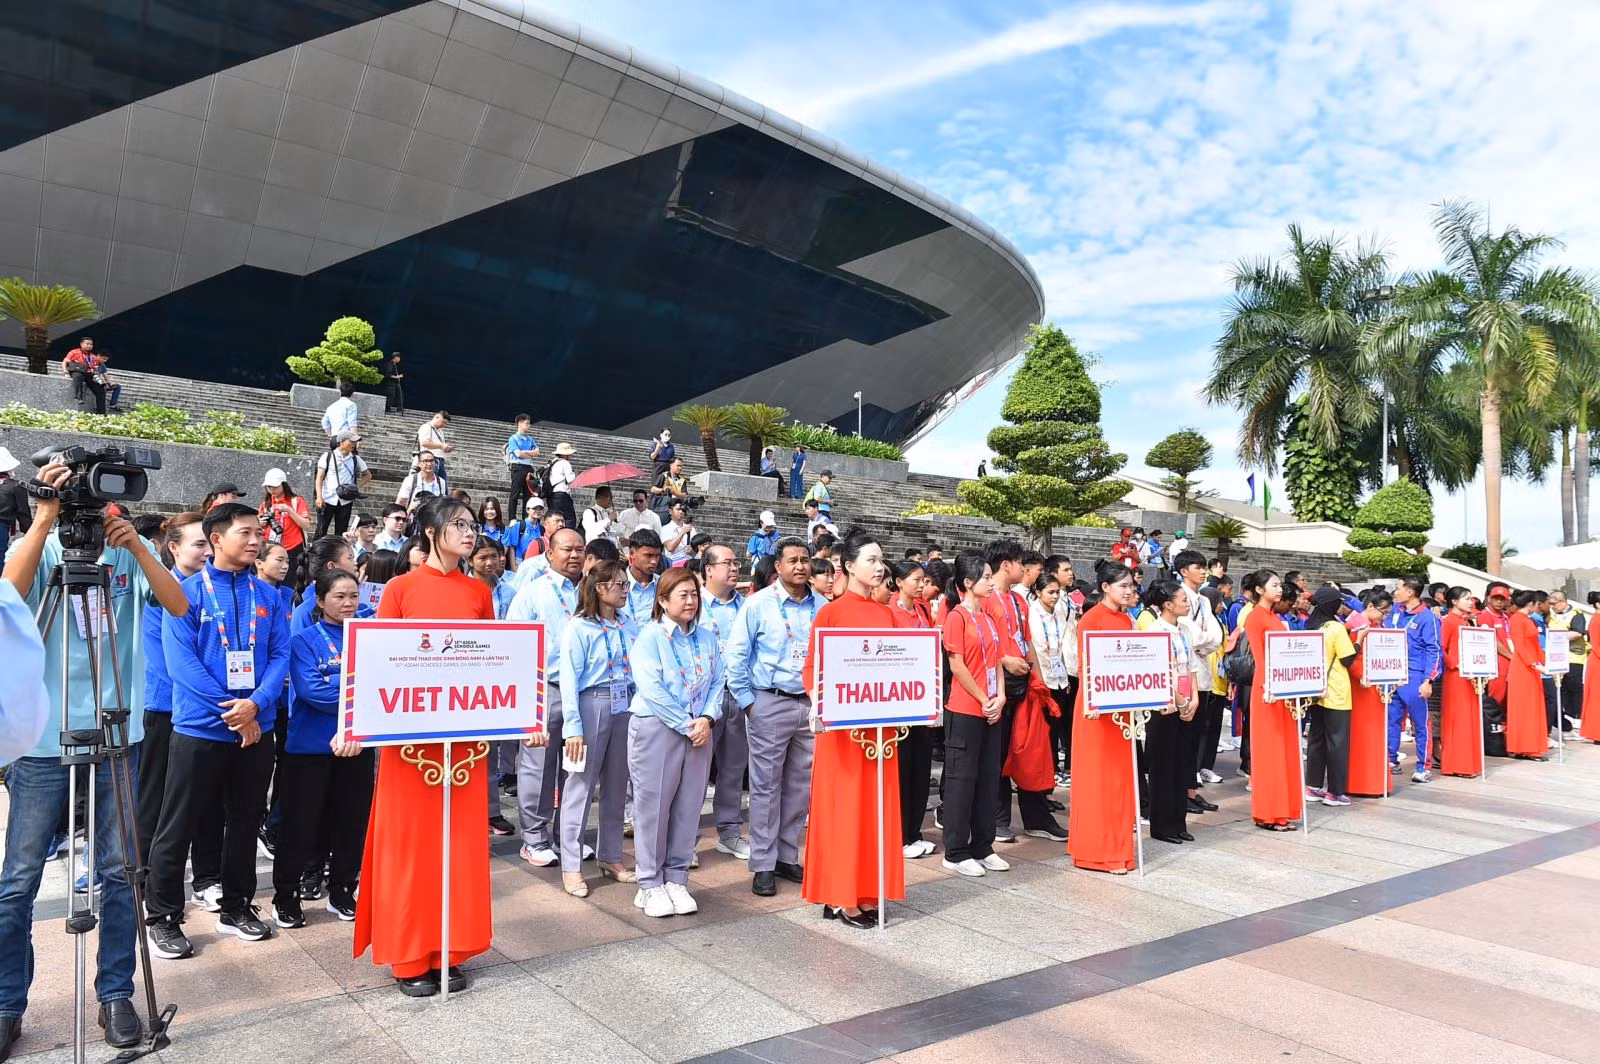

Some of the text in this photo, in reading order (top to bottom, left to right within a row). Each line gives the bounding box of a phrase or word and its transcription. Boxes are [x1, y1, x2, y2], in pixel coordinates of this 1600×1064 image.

[1371, 658, 1402, 670] MALAYSIA
[1472, 654, 1487, 664] LAOS
[1094, 672, 1166, 692] SINGAPORE
[1272, 666, 1321, 682] PHILIPPINES
[378, 684, 516, 713] VIET NAM
[835, 681, 926, 704] THAILAND
